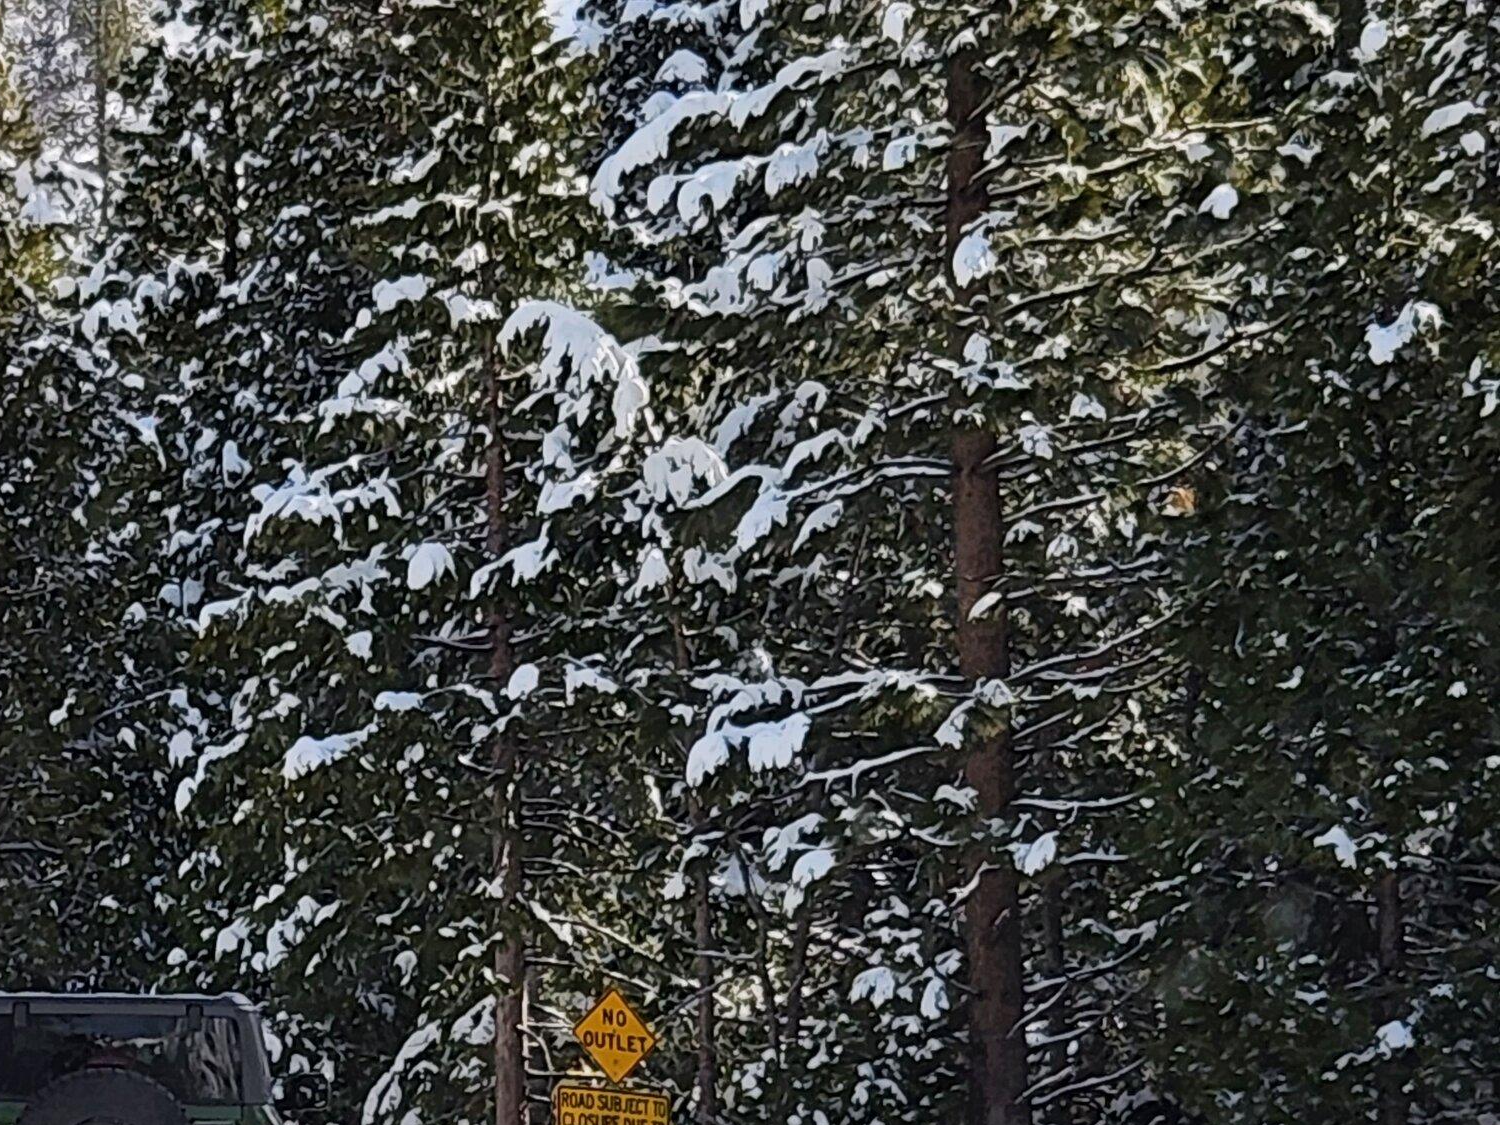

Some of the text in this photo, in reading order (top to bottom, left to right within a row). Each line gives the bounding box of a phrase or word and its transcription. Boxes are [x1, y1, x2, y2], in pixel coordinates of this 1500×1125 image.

[602, 1008, 627, 1027] NO
[583, 1030, 647, 1053] OUTLET
[561, 1092, 666, 1118] ROAD SUBJECT TO
